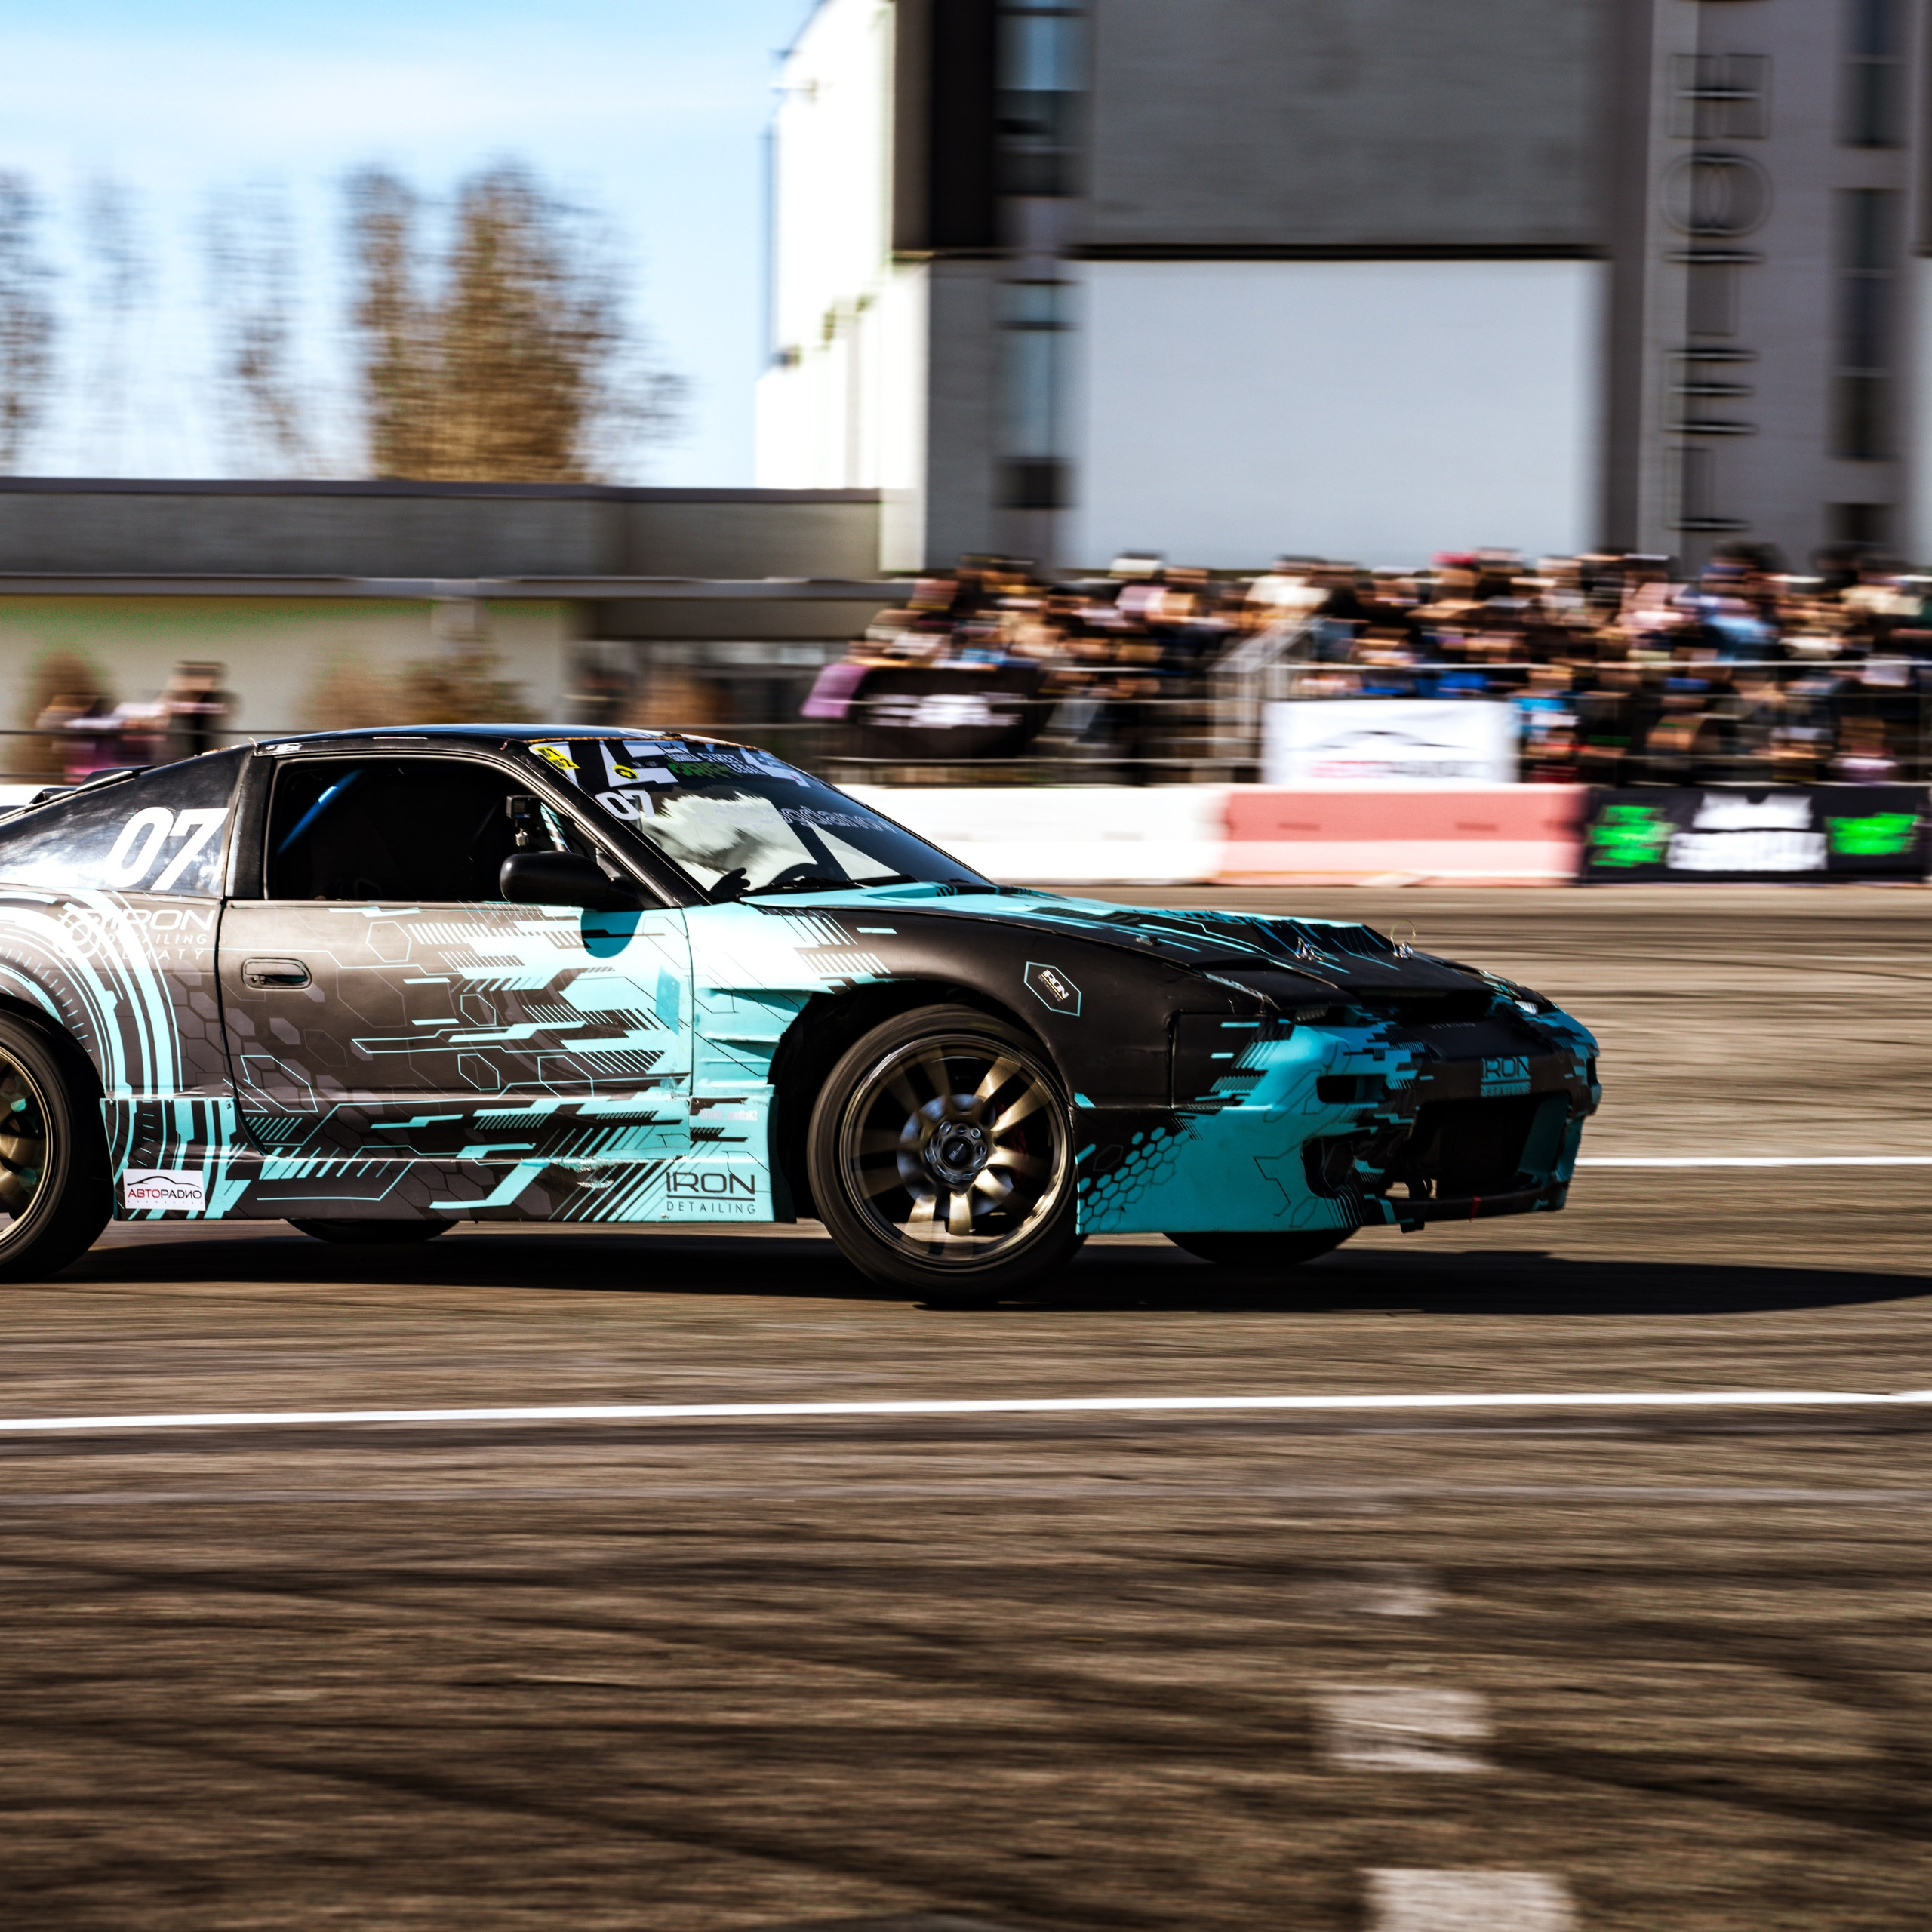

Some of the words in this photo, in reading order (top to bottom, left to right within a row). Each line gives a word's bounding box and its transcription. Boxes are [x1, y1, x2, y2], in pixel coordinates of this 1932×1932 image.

[595, 789, 655, 820] 07
[105, 806, 229, 891] 07
[111, 909, 216, 931] IRON
[107, 933, 208, 945] DAILING
[1042, 969, 1069, 999] IRON
[666, 1171, 755, 1195] IRON
[666, 1201, 756, 1214] DETAILING
